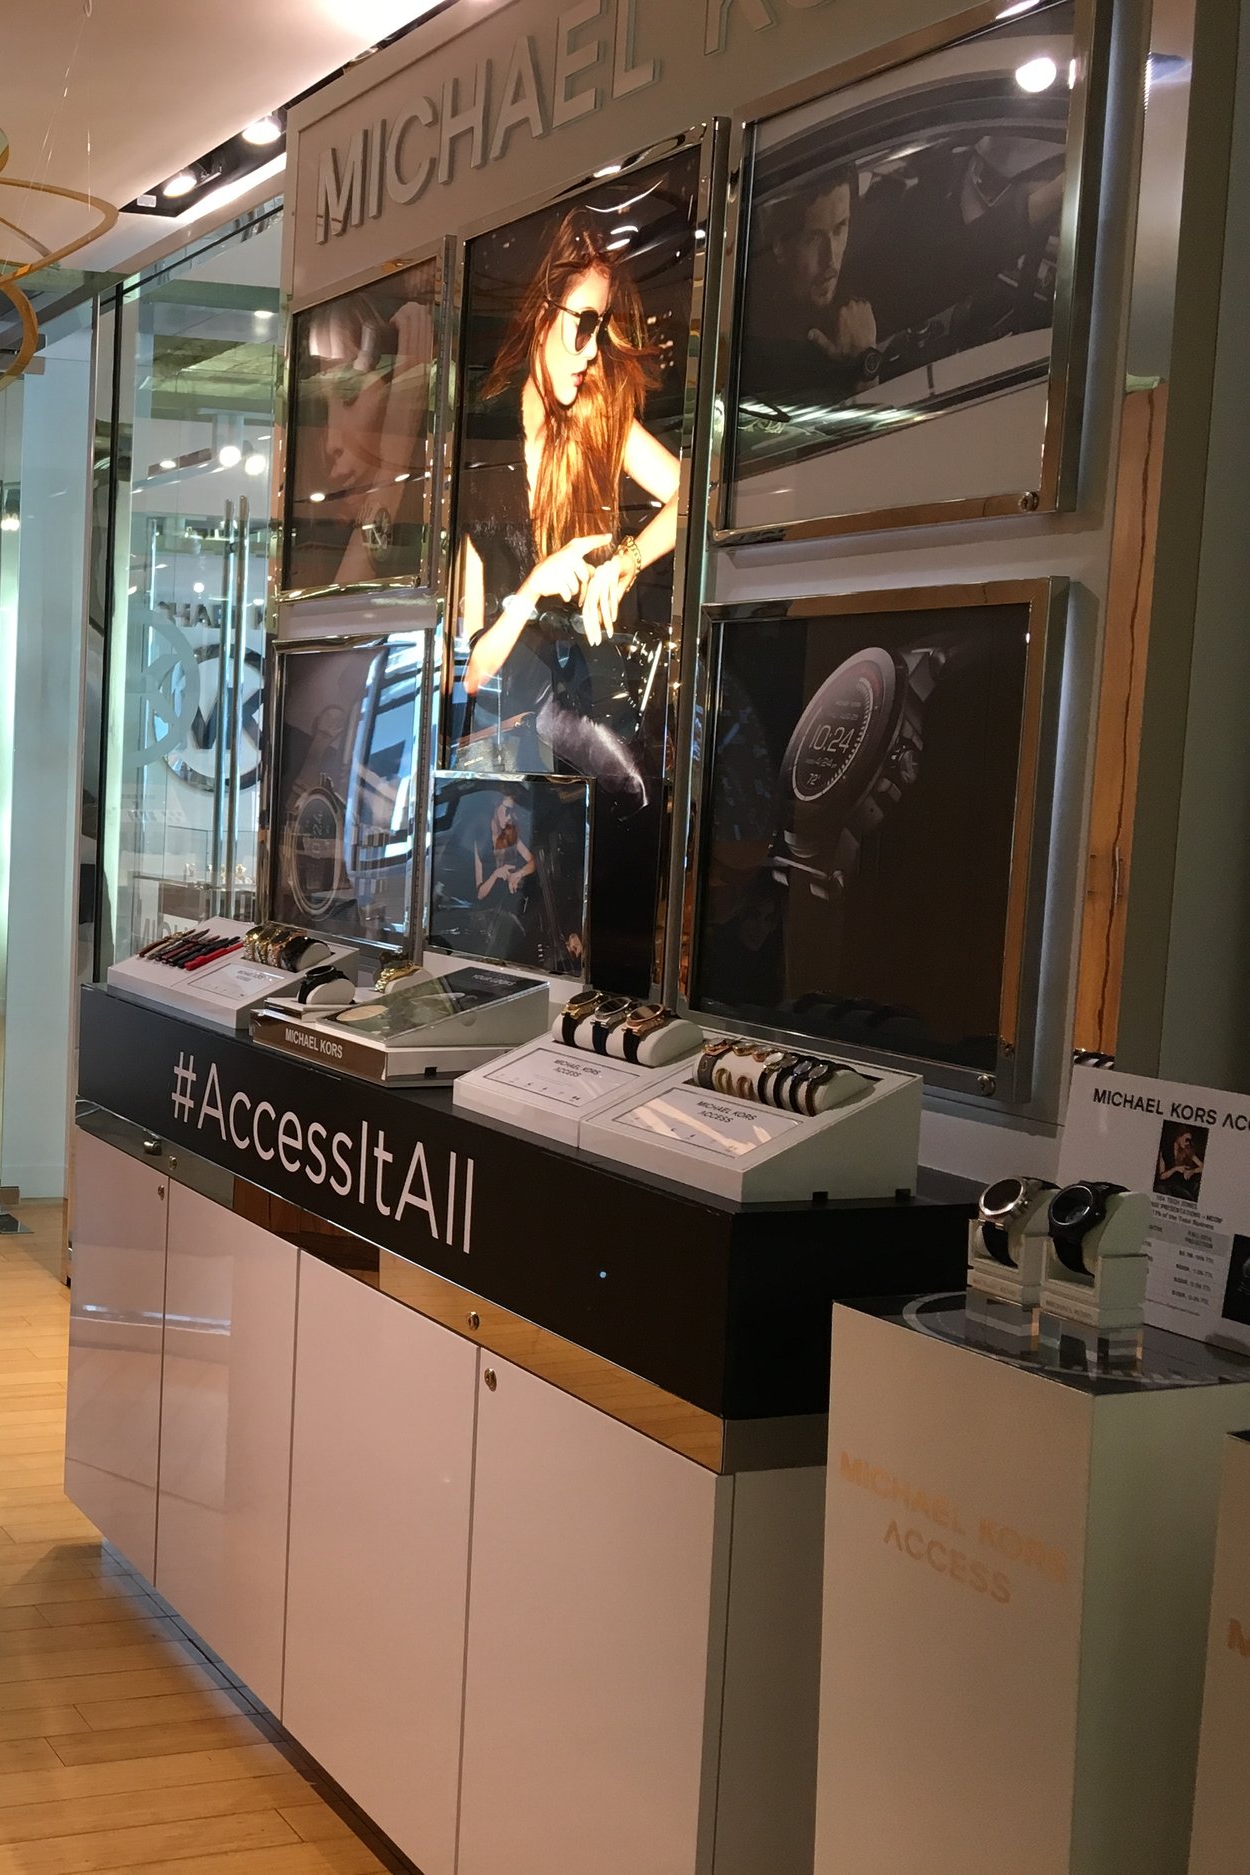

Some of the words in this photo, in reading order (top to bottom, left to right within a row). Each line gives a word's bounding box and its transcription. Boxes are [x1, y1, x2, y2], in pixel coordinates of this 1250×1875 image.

[315, 0, 656, 246] MICHAEL
[809, 724, 855, 754] 10:24
[285, 1027, 319, 1051] MICHAEL
[319, 1035, 343, 1059] KORS
[1093, 1088, 1164, 1115] MICHAEL
[1170, 1102, 1217, 1125] KORS
[171, 1051, 474, 1254] #AccessItAll
[839, 1451, 967, 1536] MICHAEL
[978, 1518, 1068, 1585] KORS
[883, 1520, 1011, 1604] ACCESS
